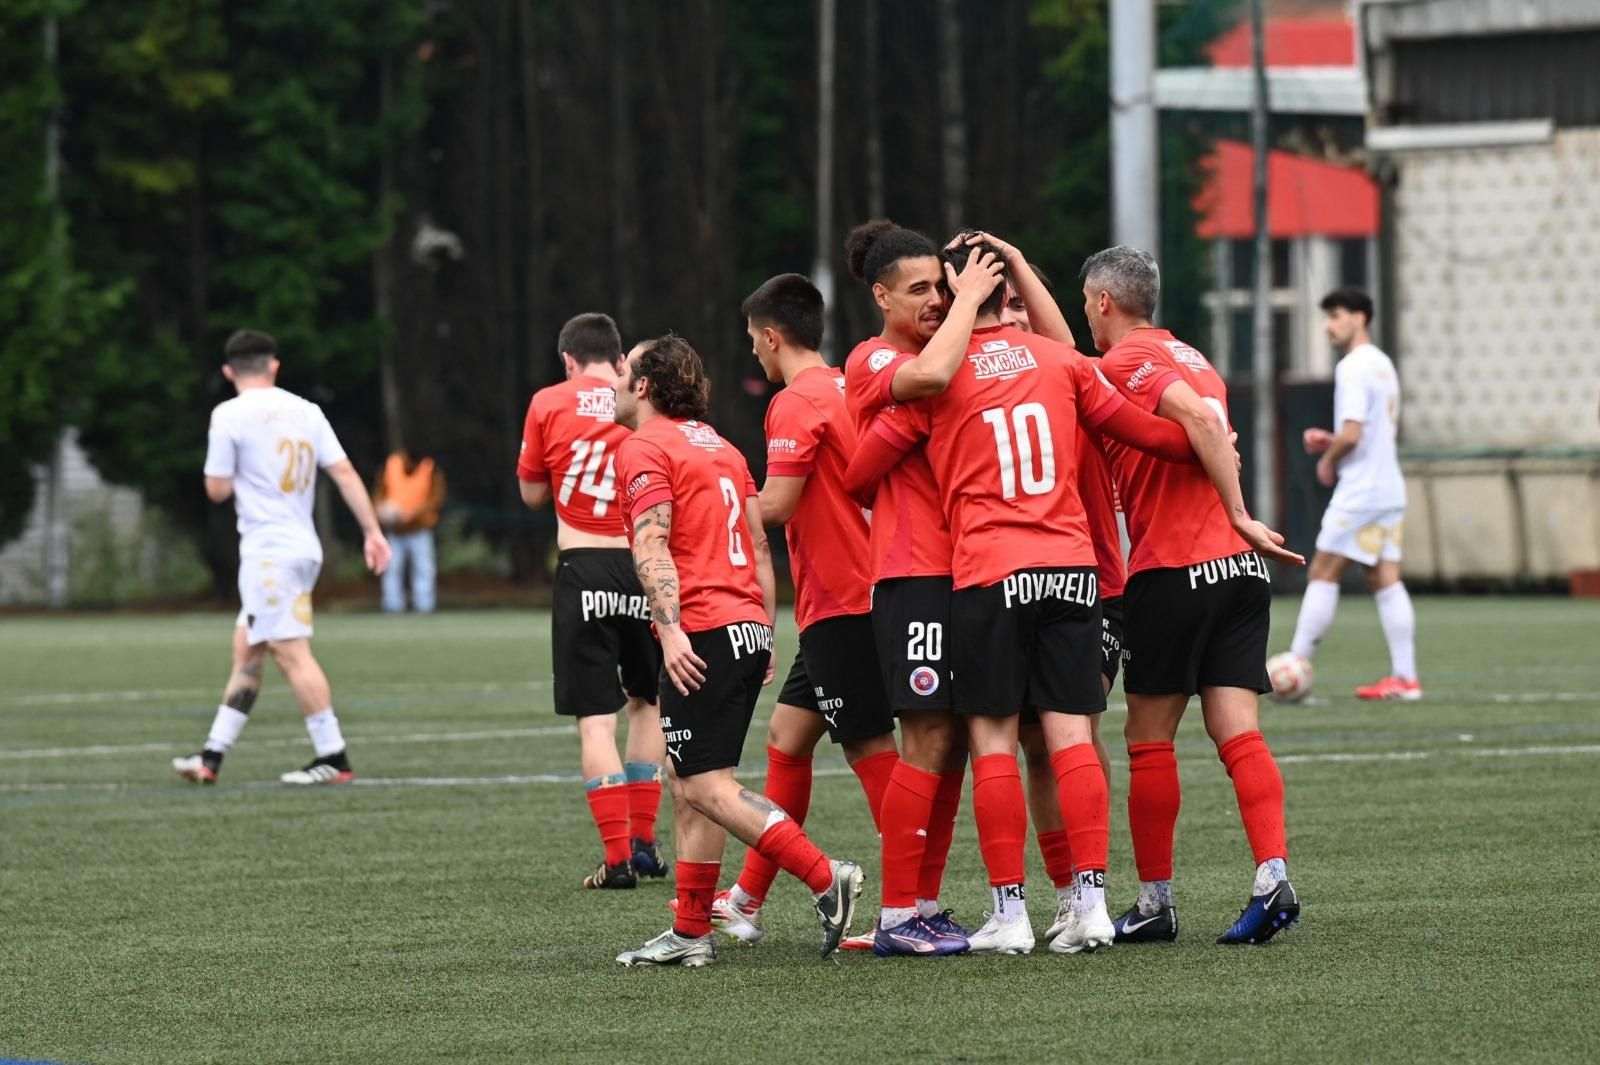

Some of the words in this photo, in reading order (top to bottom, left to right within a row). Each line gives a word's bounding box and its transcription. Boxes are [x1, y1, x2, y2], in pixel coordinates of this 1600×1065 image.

[277, 437, 314, 495] 20
[558, 439, 617, 518] 14
[982, 402, 1056, 499] 10
[719, 476, 748, 566] 2
[581, 590, 655, 622] POVARE
[1003, 572, 1097, 609] POVARELO
[907, 621, 942, 661] 20
